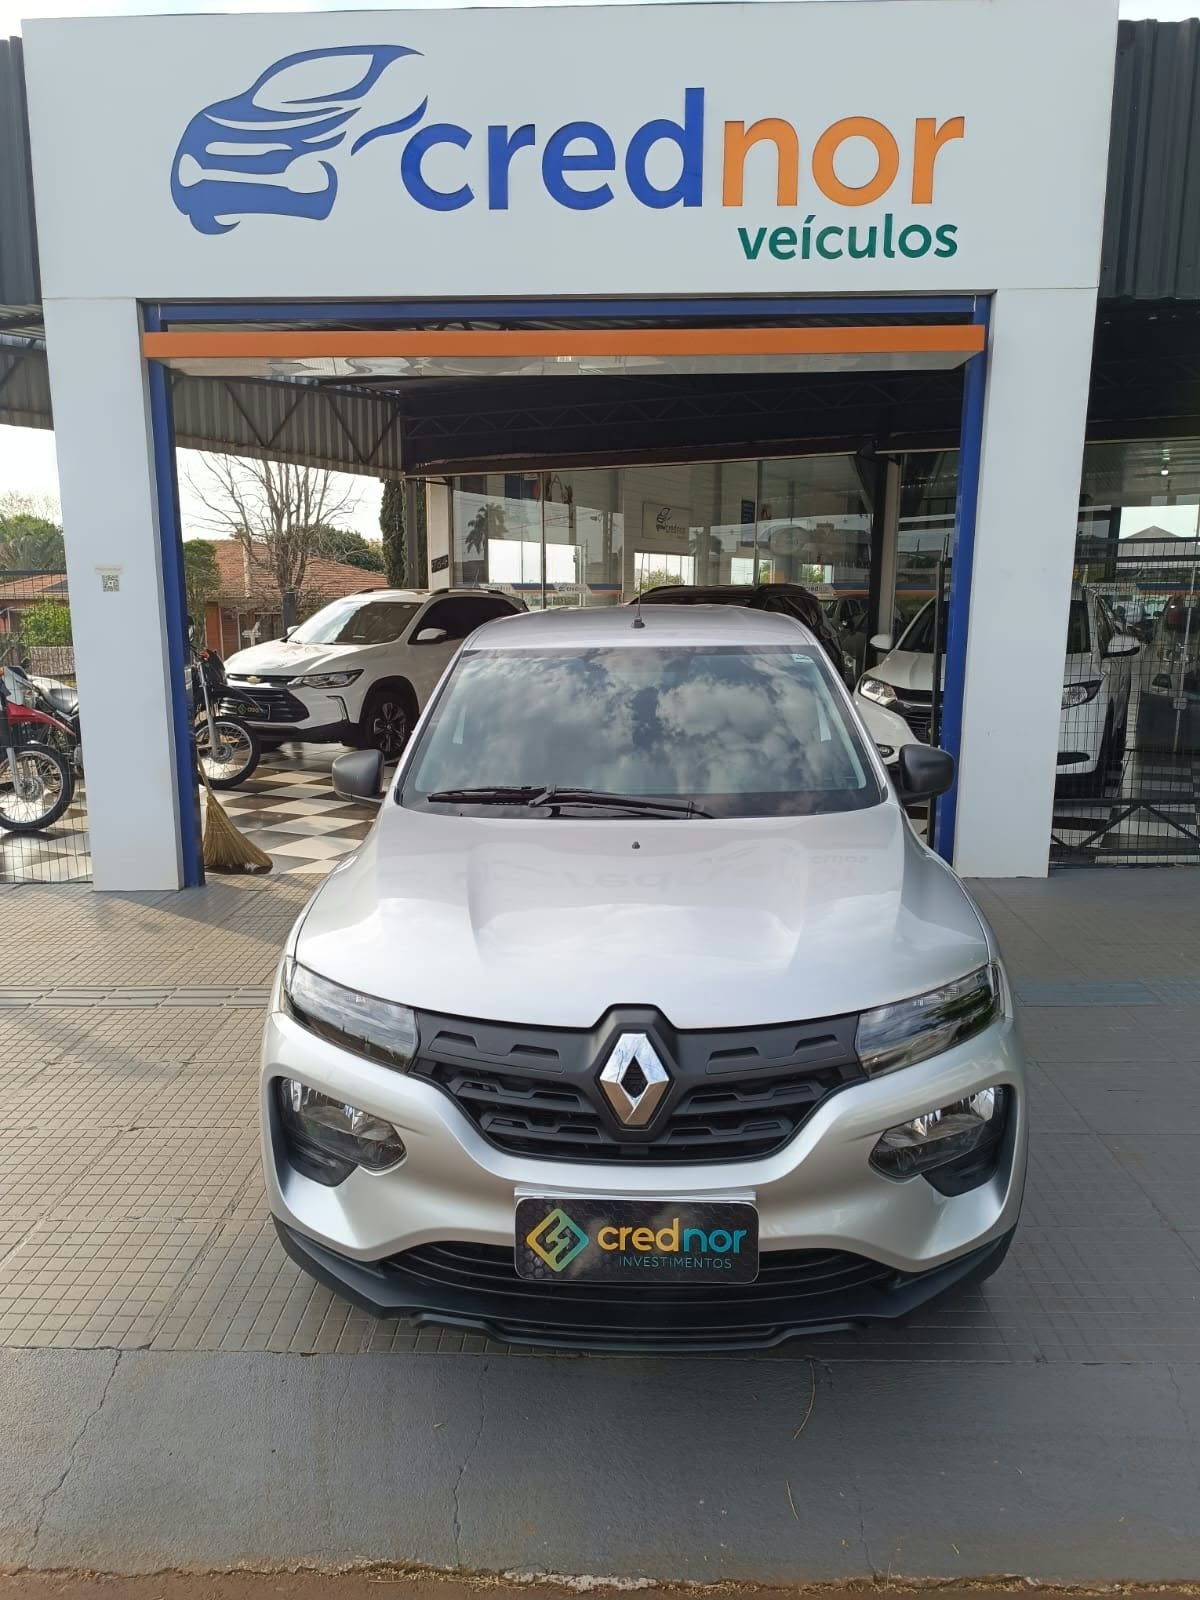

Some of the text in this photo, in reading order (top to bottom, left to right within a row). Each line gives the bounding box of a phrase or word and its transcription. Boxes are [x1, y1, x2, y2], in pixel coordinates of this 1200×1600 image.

[400, 87, 964, 212] crednor
[738, 214, 958, 260] veículos
[597, 1217, 747, 1253] crednor
[619, 1255, 732, 1269] INVESTIMENTOS
